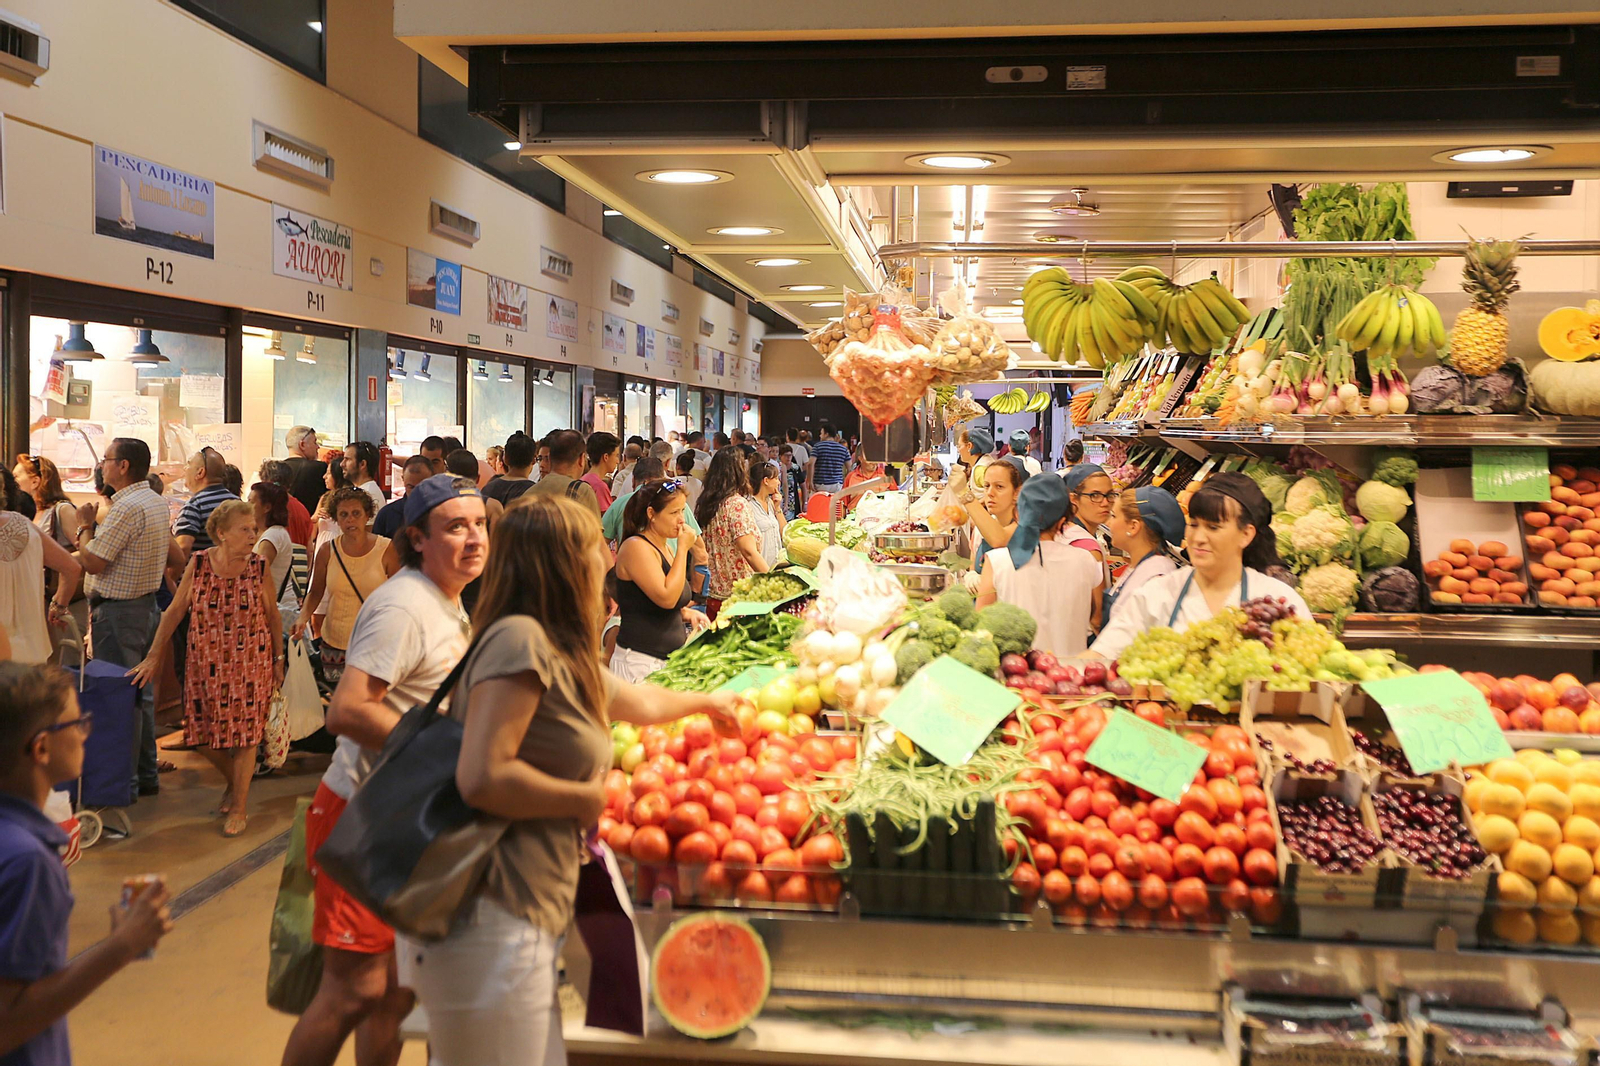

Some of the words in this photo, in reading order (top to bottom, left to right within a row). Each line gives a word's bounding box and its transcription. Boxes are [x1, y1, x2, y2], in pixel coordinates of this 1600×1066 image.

[100, 148, 210, 195] PESCADERIA
[146, 257, 173, 285] P-12
[285, 238, 347, 288] AURORI
[307, 291, 324, 312] P-11
[430, 317, 443, 335] P-10
[1160, 401, 1173, 414] Val
[1168, 373, 1192, 402] Venosta
